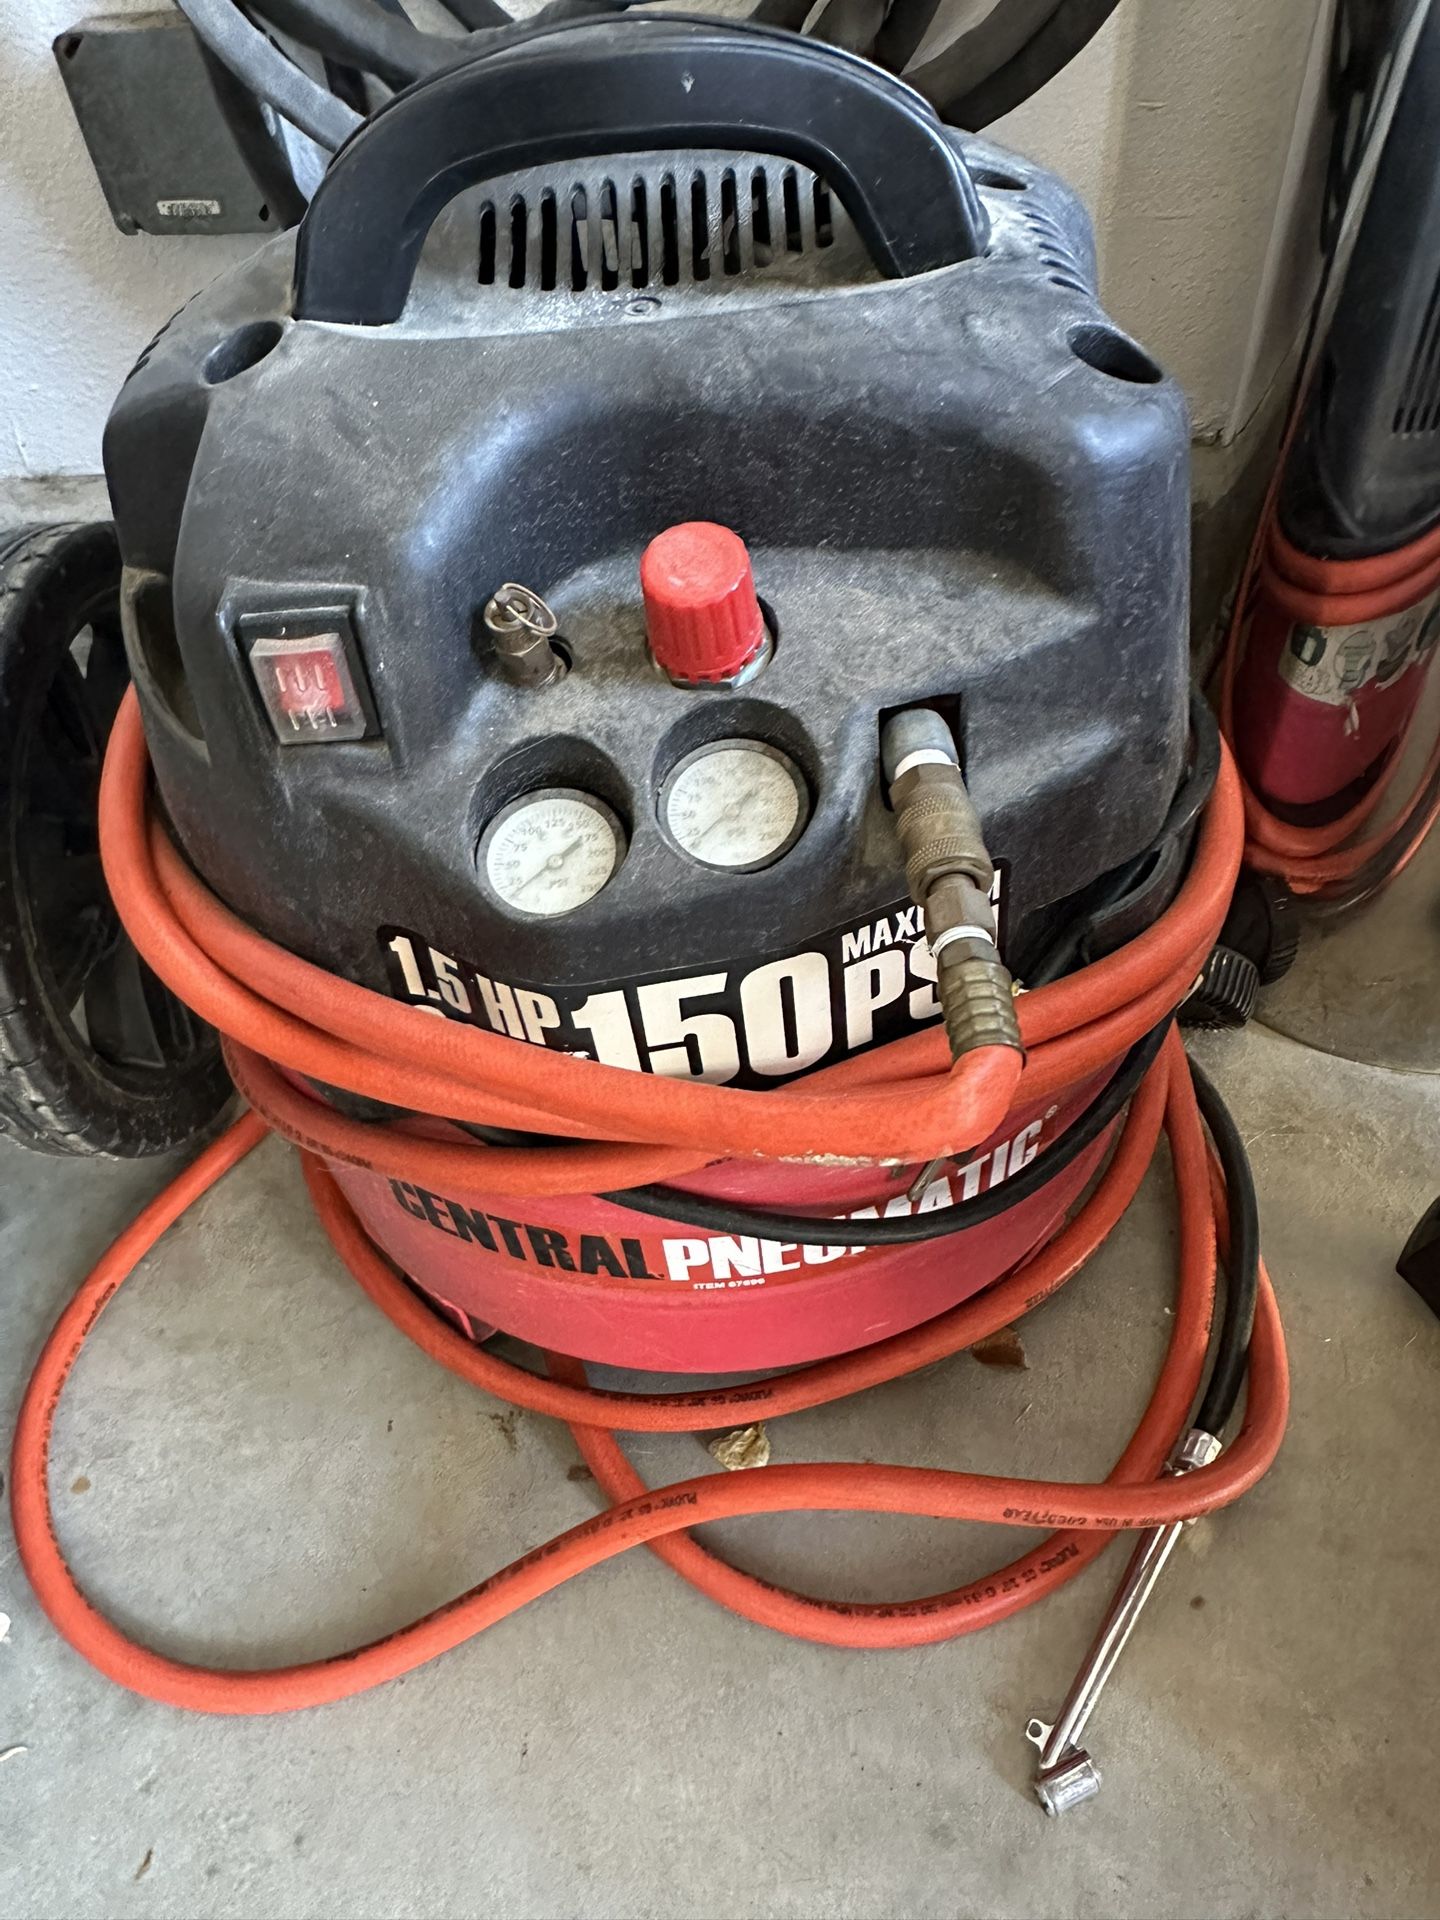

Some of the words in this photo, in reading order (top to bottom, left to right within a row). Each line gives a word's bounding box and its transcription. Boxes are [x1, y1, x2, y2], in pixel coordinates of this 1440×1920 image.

[389, 936, 471, 1014] 1.5
[476, 973, 561, 1045] HP
[570, 951, 834, 1087] 150
[388, 1176, 656, 1280] CENTRAL
[693, 1282, 725, 1290] ITEM
